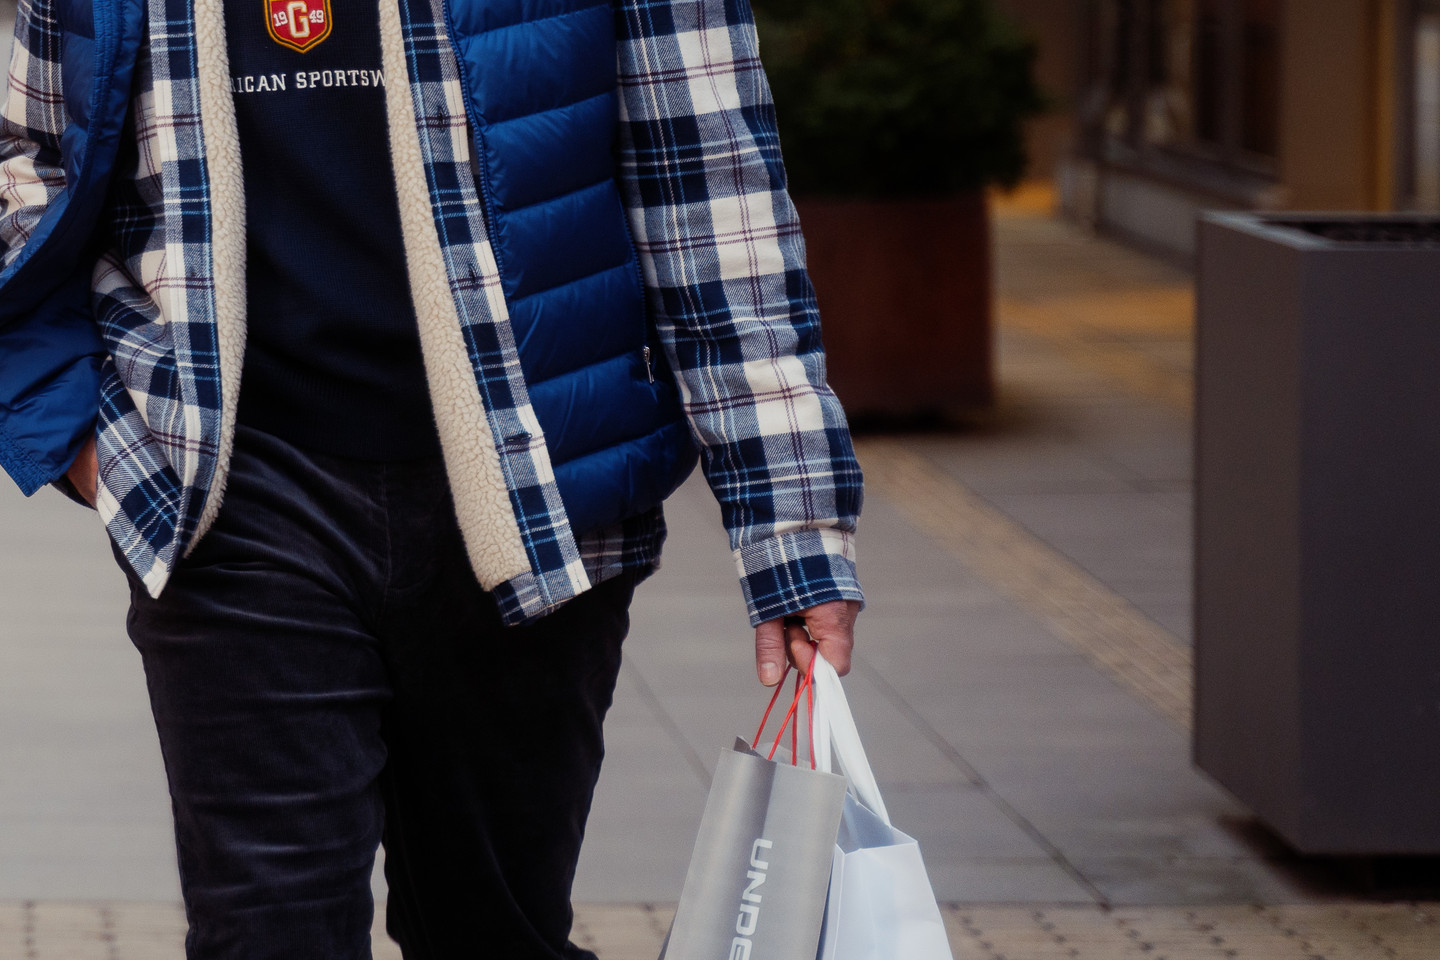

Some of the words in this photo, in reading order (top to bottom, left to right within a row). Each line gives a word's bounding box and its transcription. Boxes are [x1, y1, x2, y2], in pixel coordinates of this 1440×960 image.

[273, 11, 289, 27] 19
[287, 1, 311, 38] G
[308, 10, 325, 24] 49
